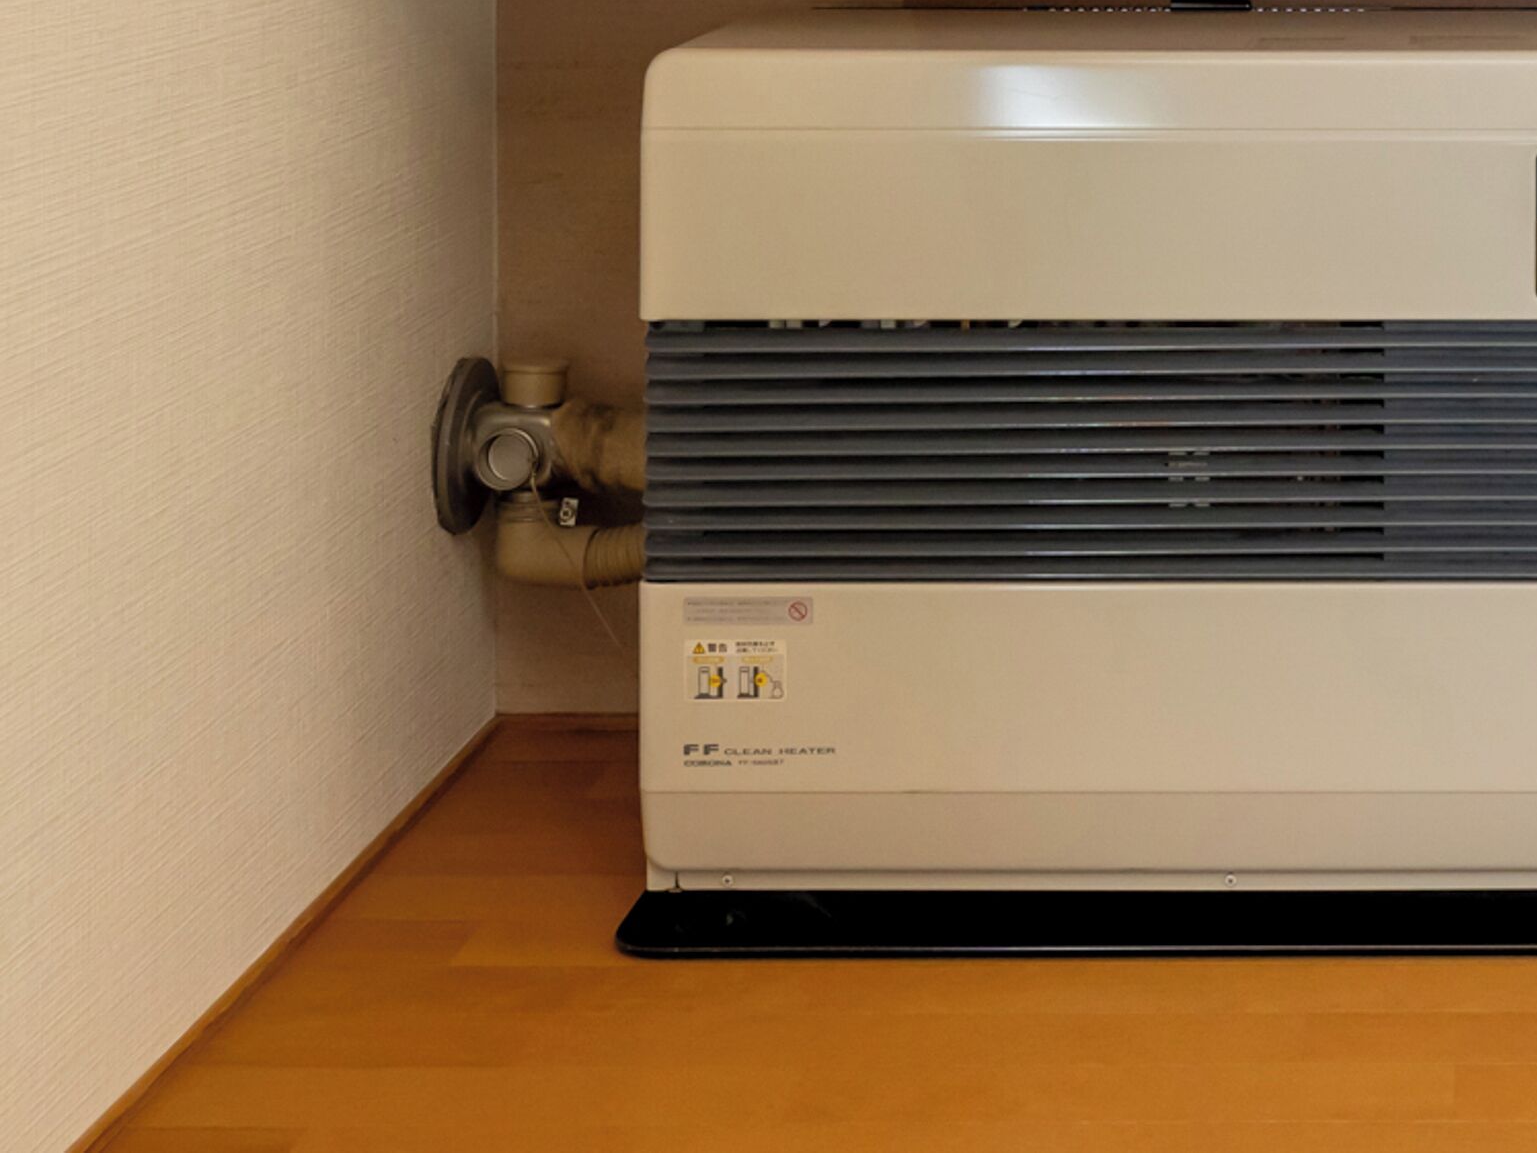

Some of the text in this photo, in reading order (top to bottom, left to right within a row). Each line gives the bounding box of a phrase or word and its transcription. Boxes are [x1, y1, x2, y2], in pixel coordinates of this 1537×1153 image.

[683, 743, 836, 756] FF CLEAN HEATER
[683, 759, 732, 767] CORONA
